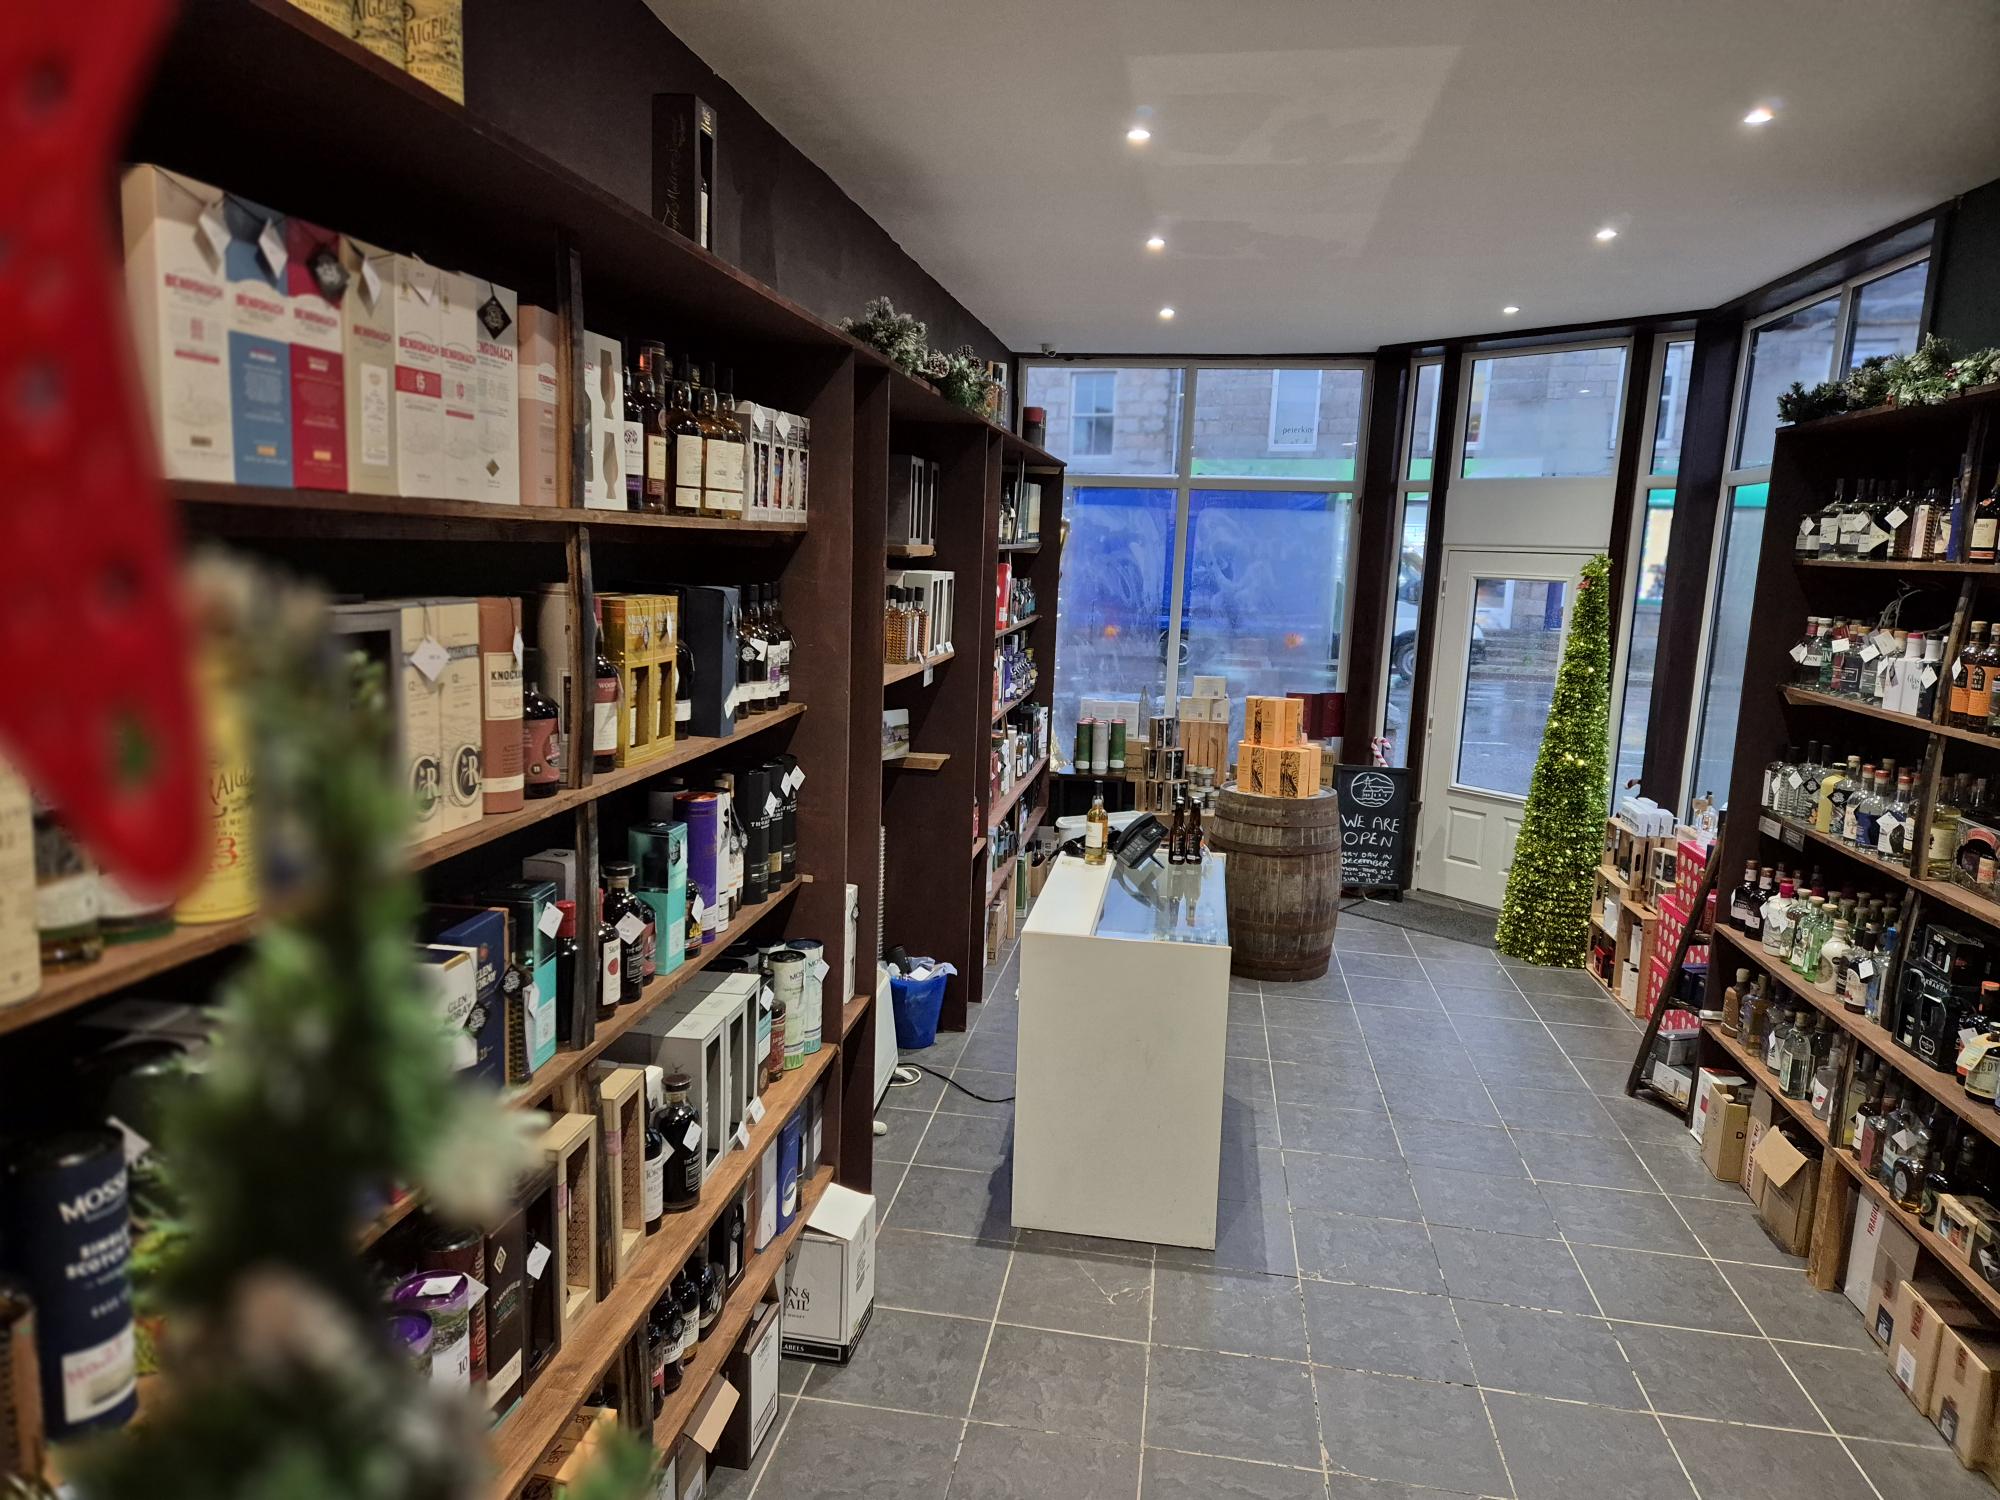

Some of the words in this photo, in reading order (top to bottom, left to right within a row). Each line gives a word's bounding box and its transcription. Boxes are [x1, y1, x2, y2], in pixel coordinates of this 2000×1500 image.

[1341, 813, 1366, 828] WE
[1372, 816, 1400, 834] ARE
[1343, 831, 1393, 848] OPEN
[1361, 851, 1379, 859] DAY
[1924, 978, 1949, 994] KRAKEN
[458, 1355, 468, 1375] 10
